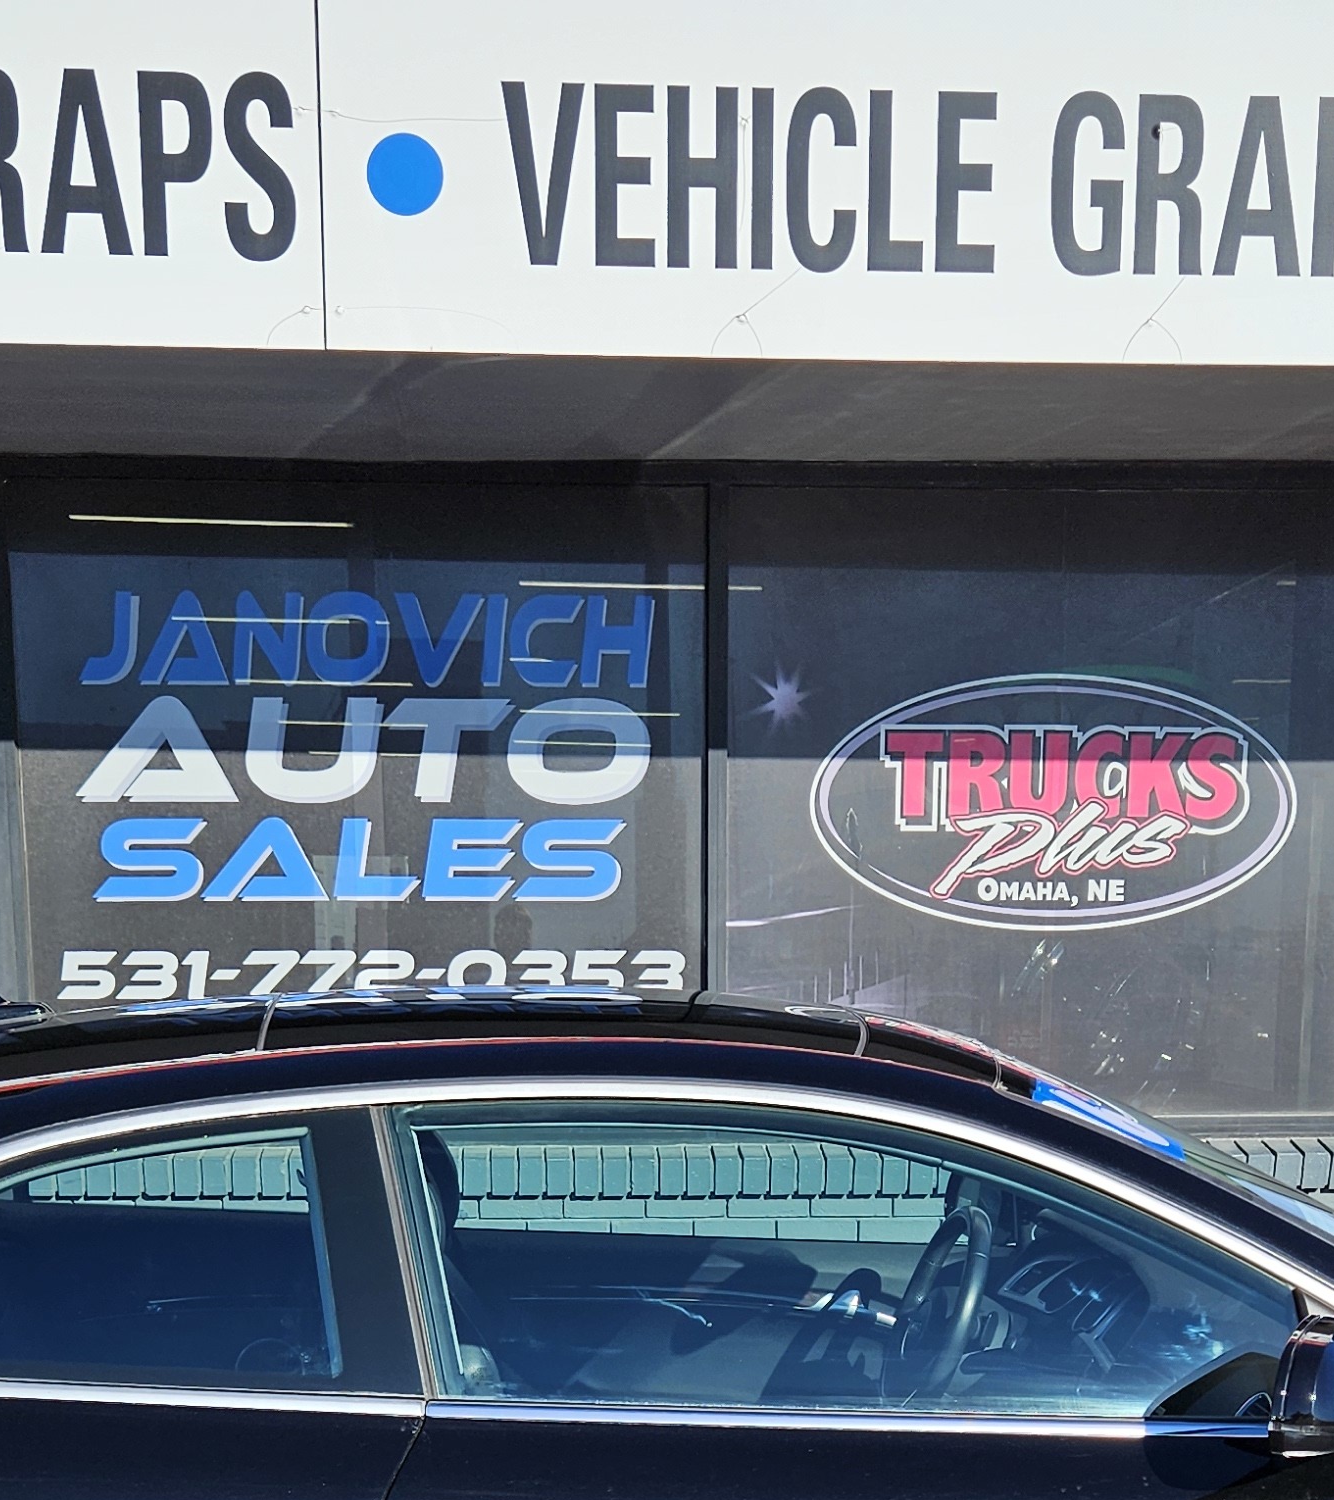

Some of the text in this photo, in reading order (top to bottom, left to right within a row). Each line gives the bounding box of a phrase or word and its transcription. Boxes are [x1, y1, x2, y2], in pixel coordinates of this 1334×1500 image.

[500, 80, 999, 274] VEHICLE
[78, 589, 656, 689] JANOVICH
[75, 695, 652, 805] AUTO
[880, 724, 1250, 836] TRUCKS
[93, 816, 628, 902] SALES
[929, 798, 1192, 900] Plus
[976, 876, 1126, 907] OMAHA, NE
[55, 948, 688, 1001] 531-772-0353
